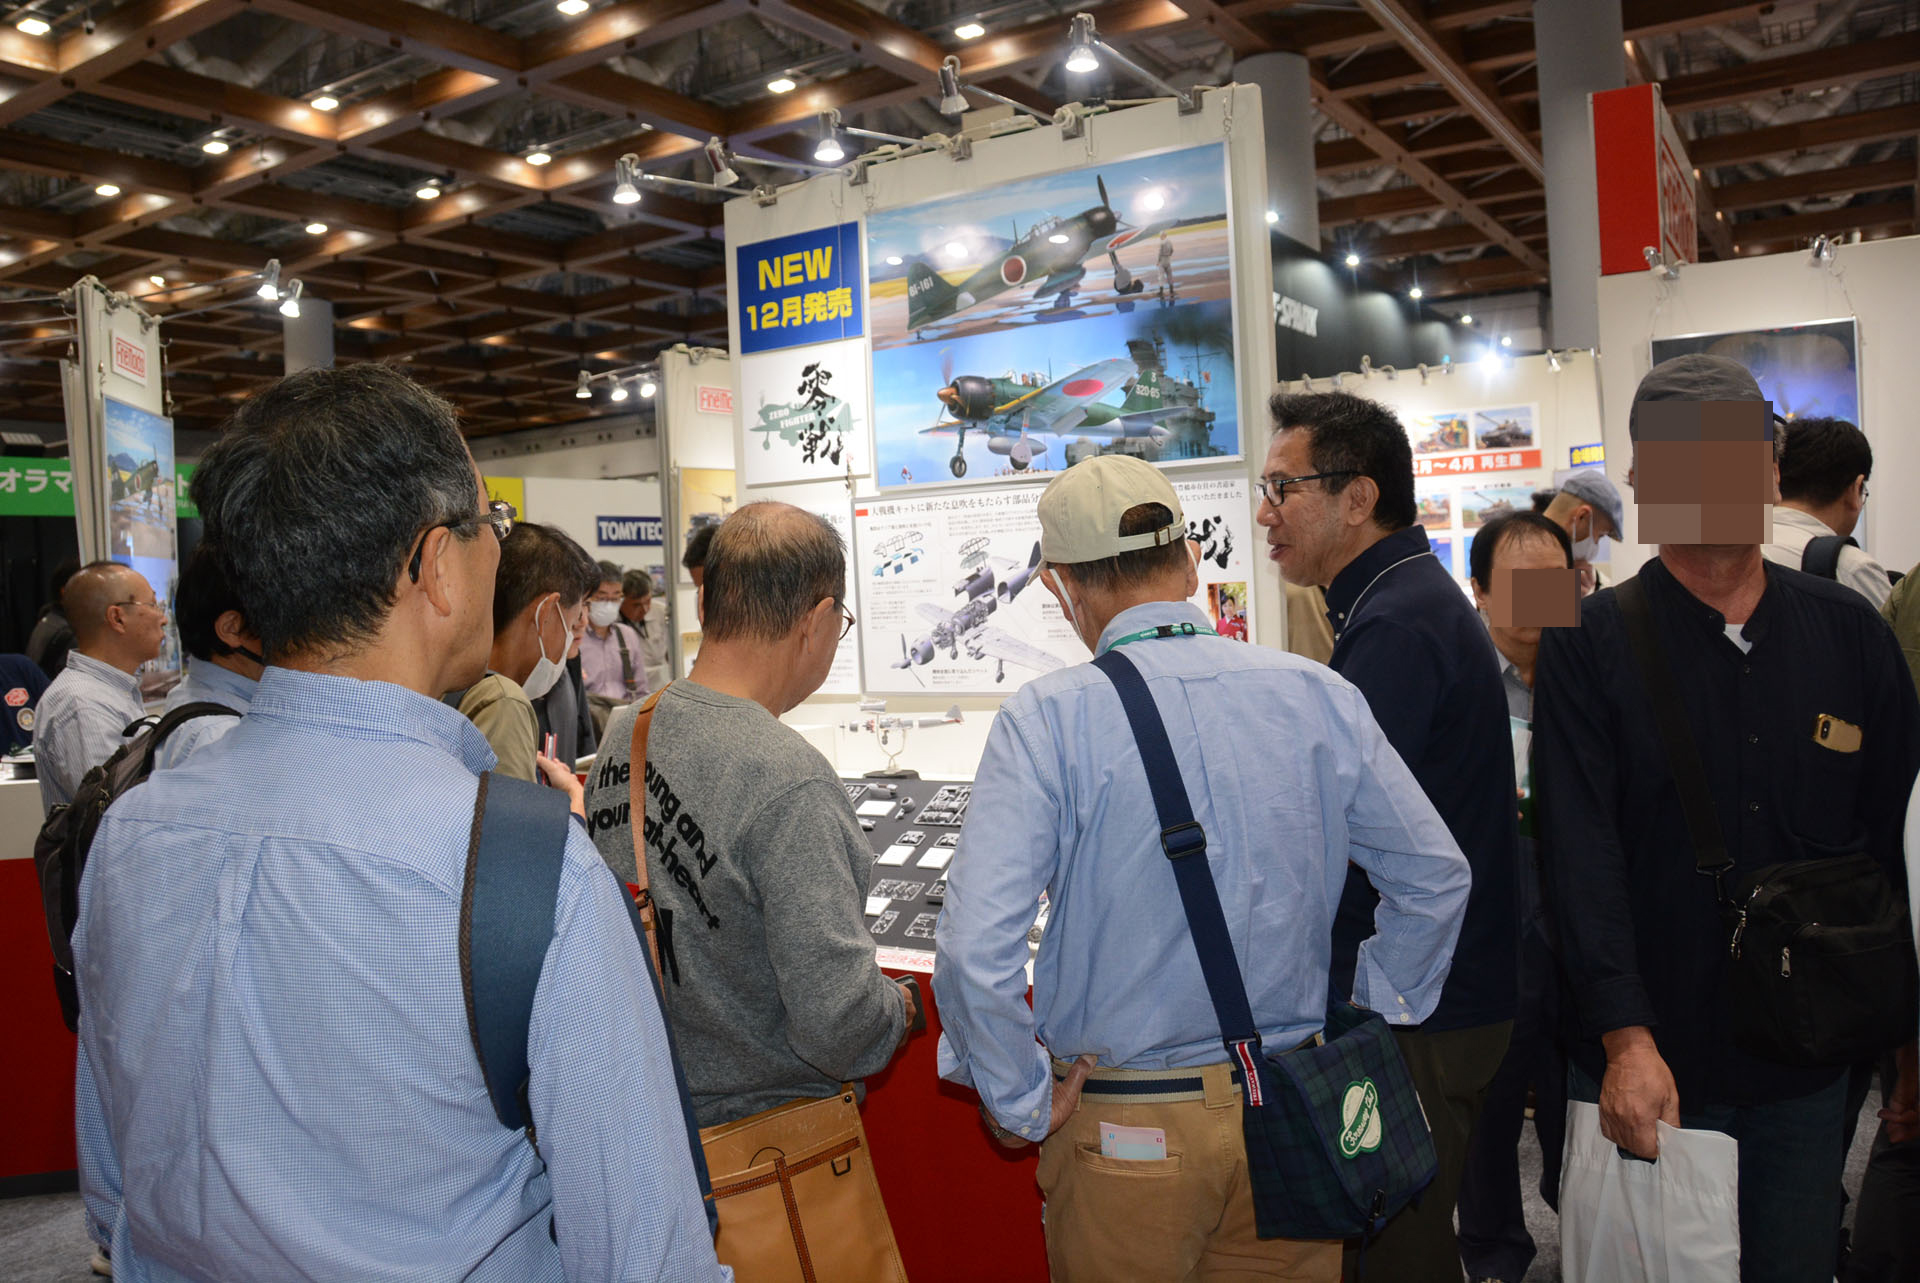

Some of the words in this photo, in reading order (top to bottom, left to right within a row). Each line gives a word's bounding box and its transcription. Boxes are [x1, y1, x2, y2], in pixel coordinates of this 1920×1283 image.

[758, 246, 833, 291] NEW
[746, 287, 852, 331] 12月発売
[769, 407, 790, 420] ZERO
[780, 412, 817, 429] FIGHTER
[599, 521, 663, 541] TOMYTEC
[598, 756, 631, 789] the
[645, 760, 681, 824] oung
[677, 813, 718, 878] and
